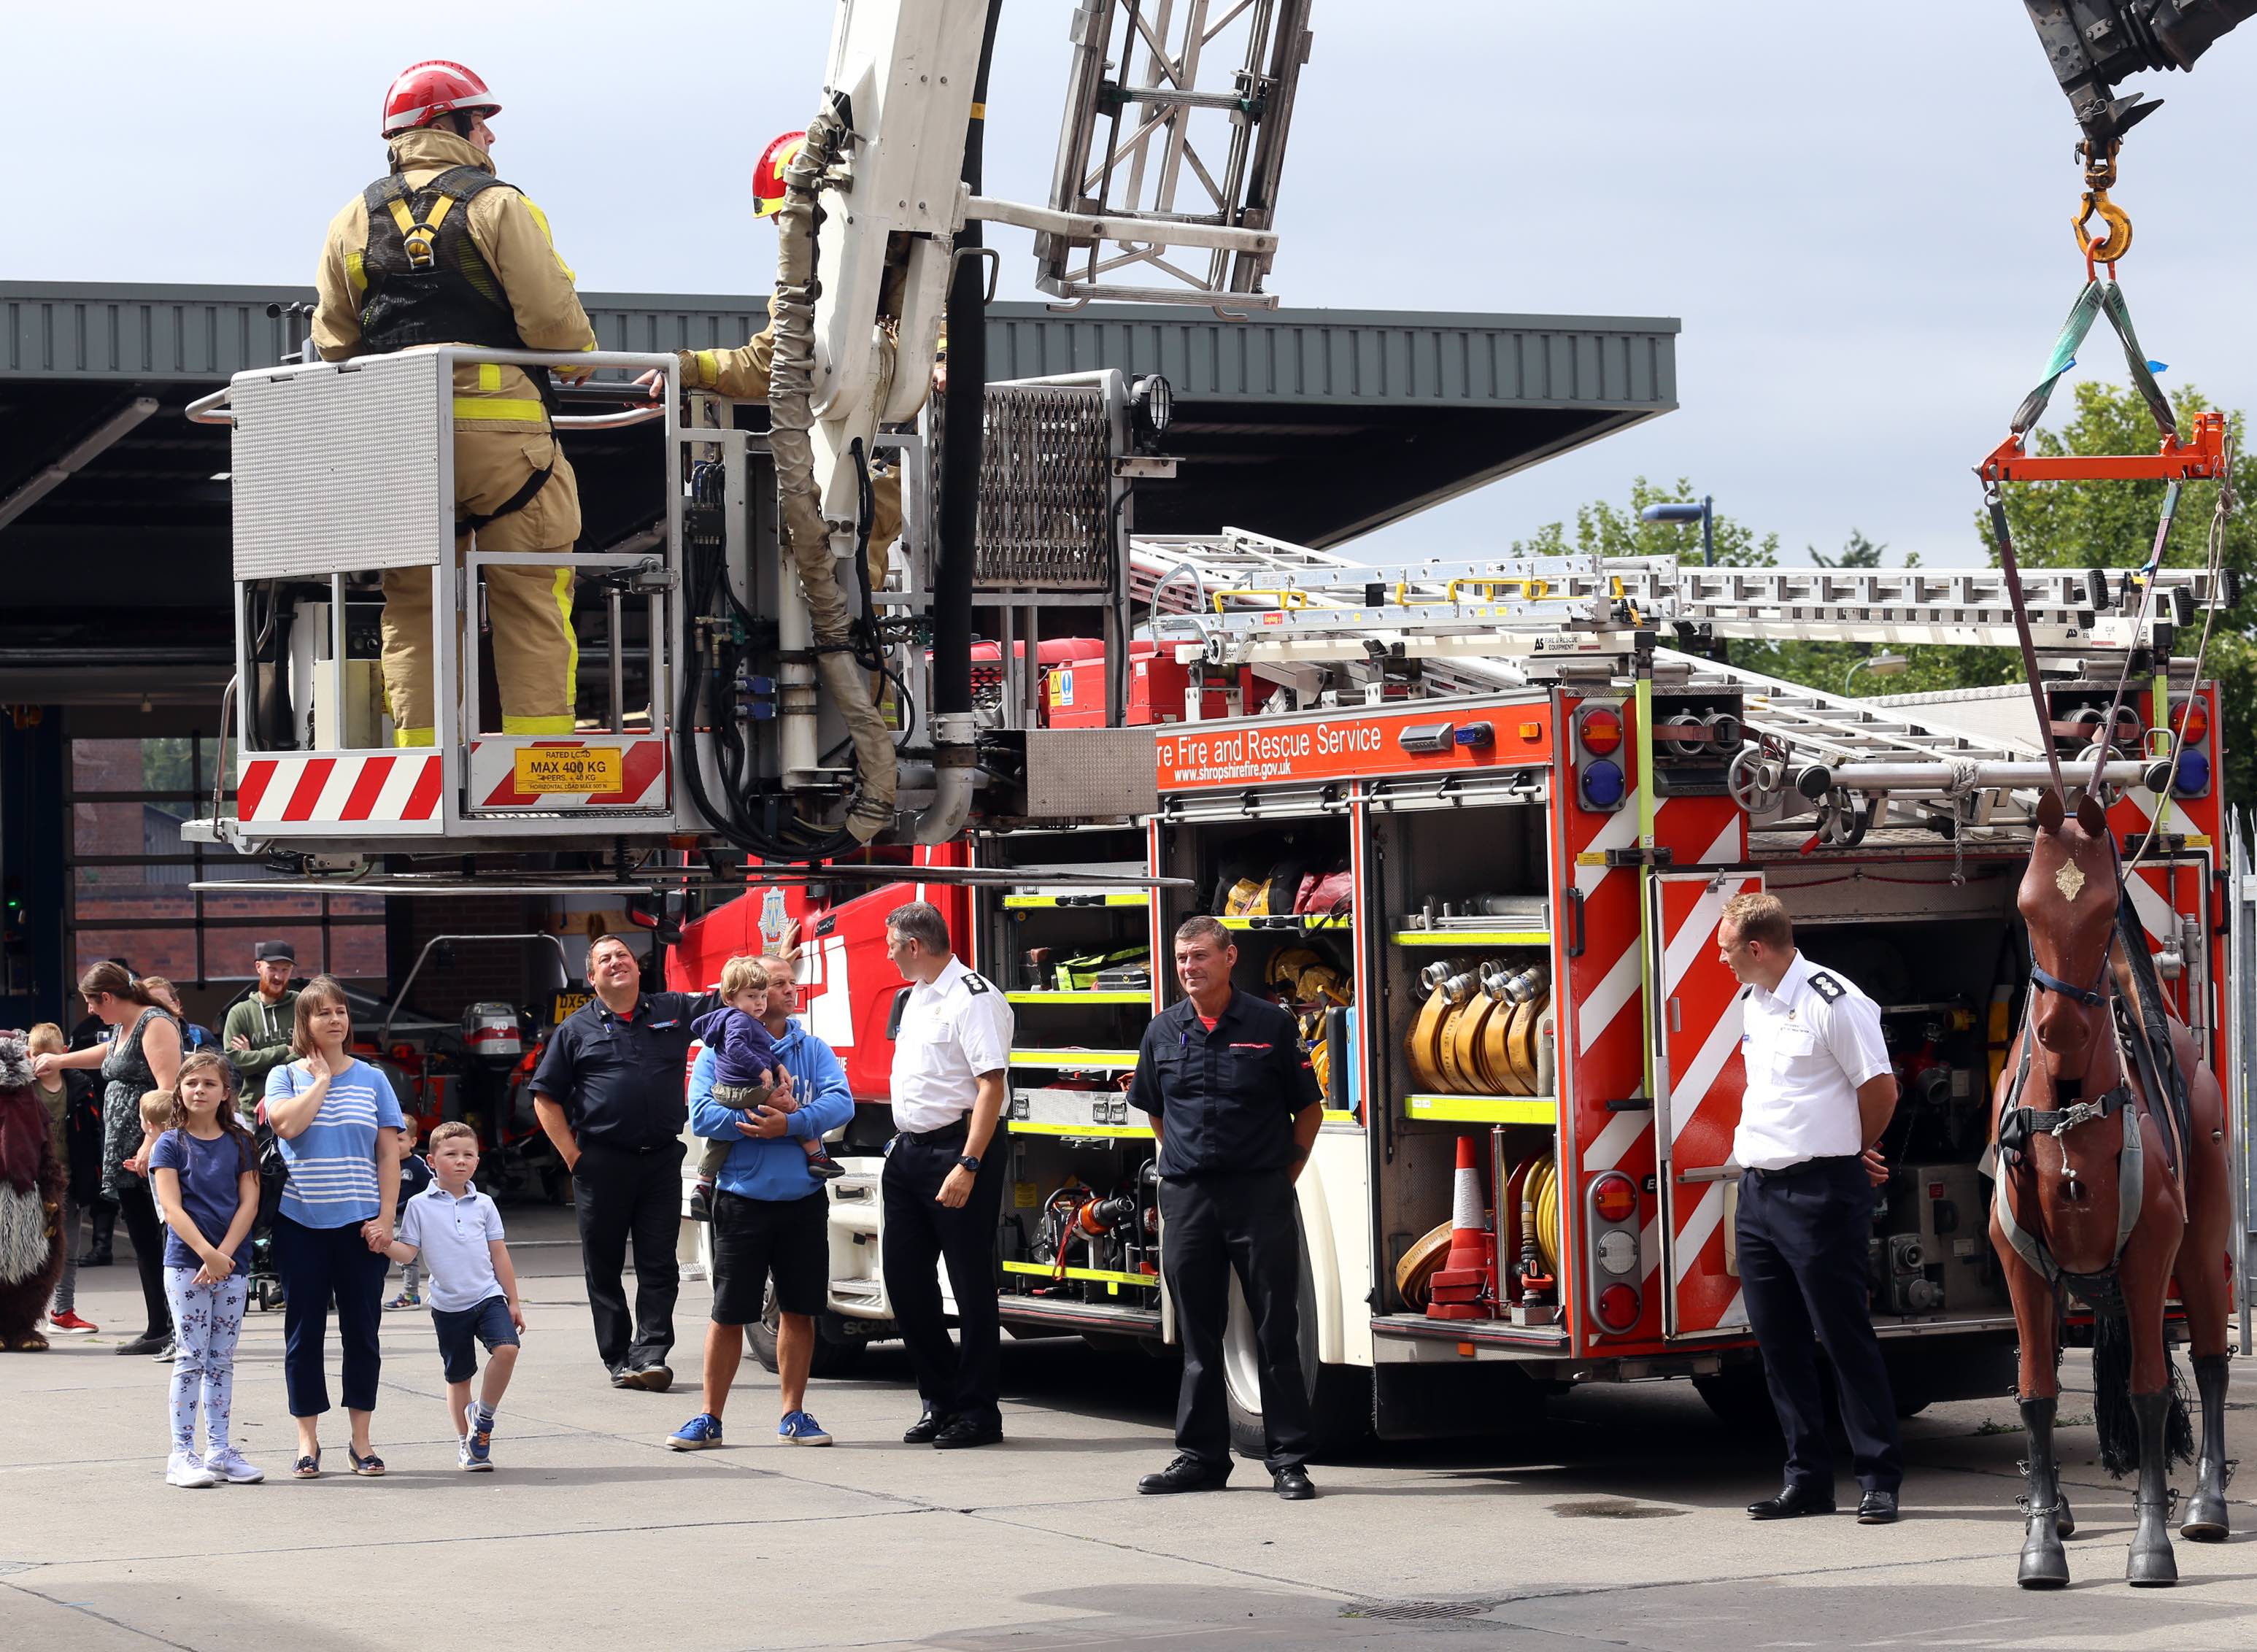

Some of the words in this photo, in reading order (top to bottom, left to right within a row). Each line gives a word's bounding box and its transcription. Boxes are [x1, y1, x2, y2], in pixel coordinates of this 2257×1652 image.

[1534, 638, 1544, 652] AS
[1178, 736, 1208, 765] Fire
[1214, 733, 1242, 763] and
[1248, 730, 1310, 760] Rescue
[1317, 721, 1381, 754] Service
[531, 762, 559, 773] MAX
[563, 761, 584, 773] 400
[587, 761, 606, 773] KG
[1174, 758, 1291, 783] www.shropshirefire.gov.uk
[492, 1021, 509, 1030] 40
